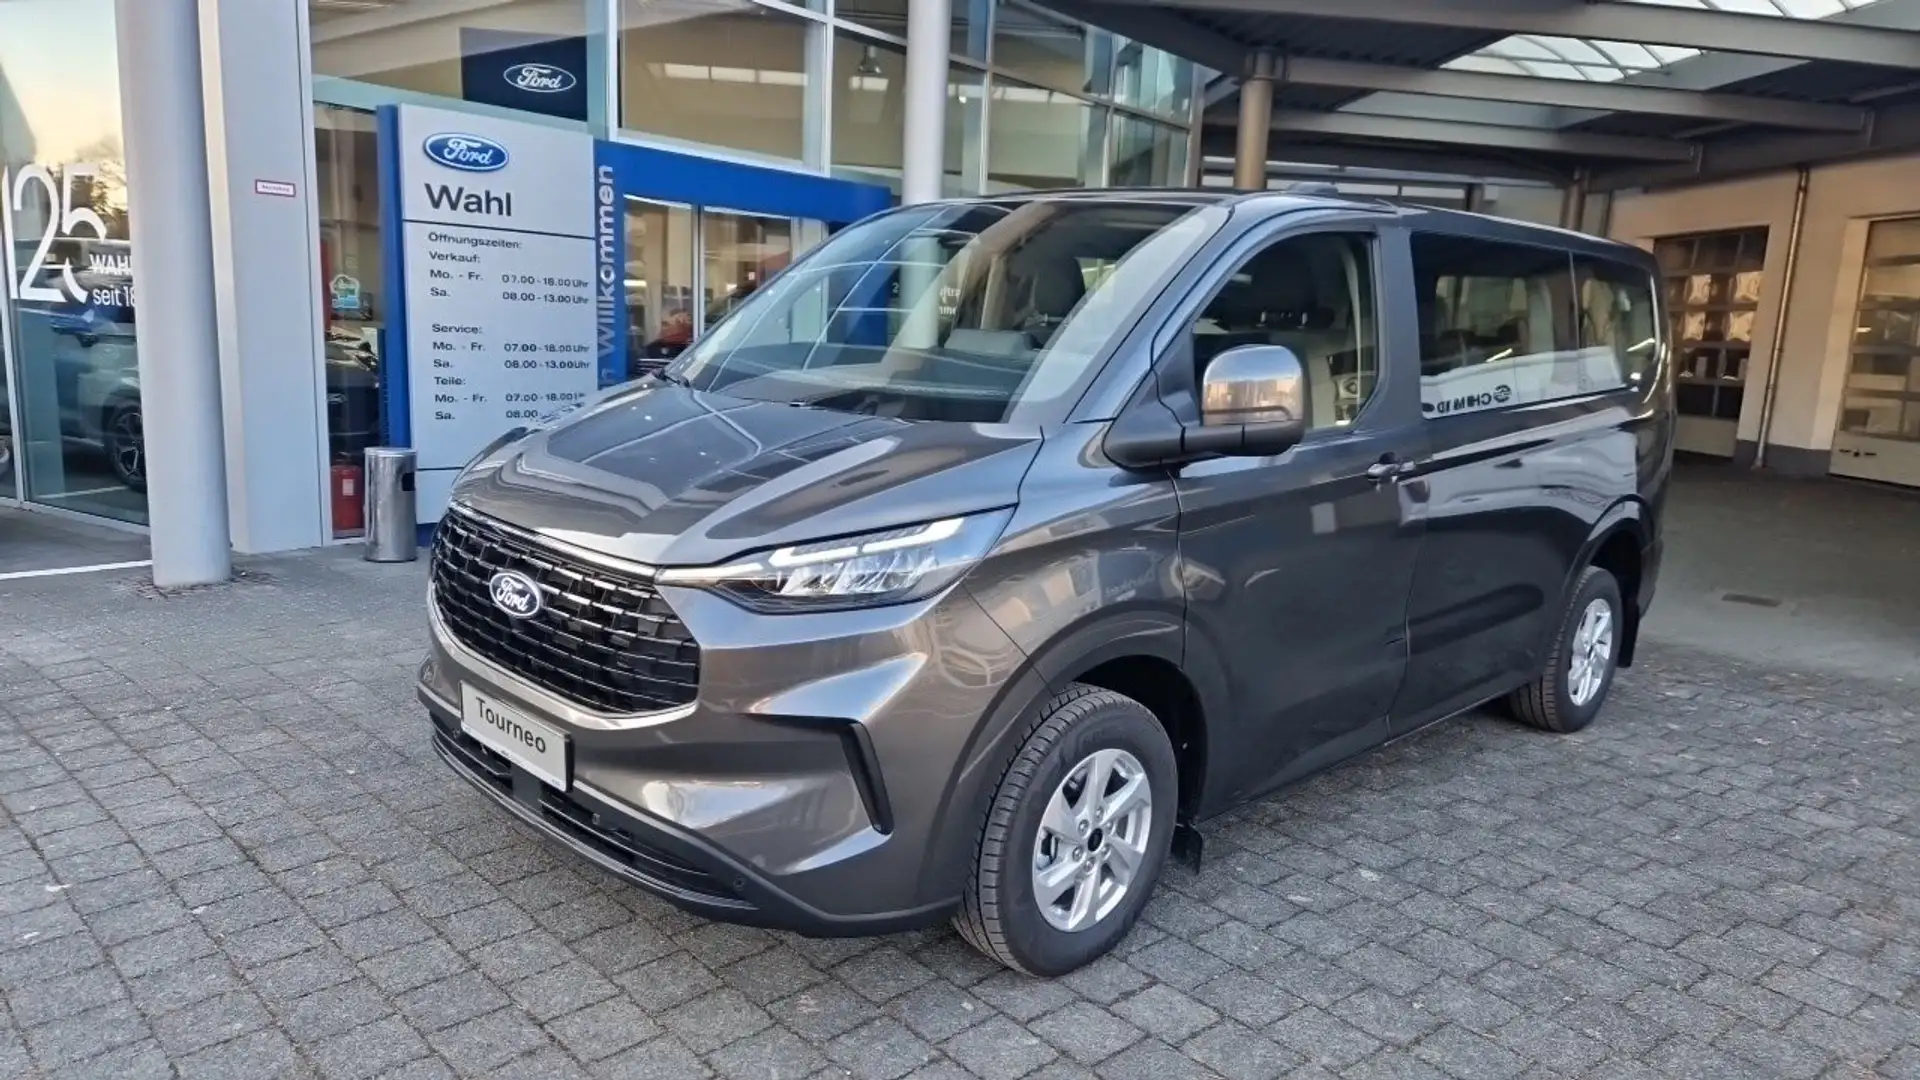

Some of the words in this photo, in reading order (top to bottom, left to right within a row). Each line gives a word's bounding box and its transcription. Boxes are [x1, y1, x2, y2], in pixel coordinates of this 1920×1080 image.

[517, 67, 562, 88] Ford
[443, 138, 494, 165] Ford
[424, 183, 512, 217] Wahl
[2, 163, 107, 304] 125
[429, 250, 481, 263] Verkauf:
[598, 165, 615, 357] Willkommen
[430, 269, 453, 279] Mo.
[468, 271, 483, 281] Fr.
[93, 284, 122, 307] seit
[430, 286, 450, 297] Sa.
[432, 323, 484, 334] Service:
[433, 341, 456, 351] Mo.
[471, 342, 486, 352] Fr.
[433, 358, 454, 369] Sa.
[434, 376, 466, 386] Teile:
[435, 393, 459, 403] Mo.
[435, 410, 455, 421] Sa.
[496, 576, 531, 611] Ford
[476, 697, 546, 753] Tourneo
